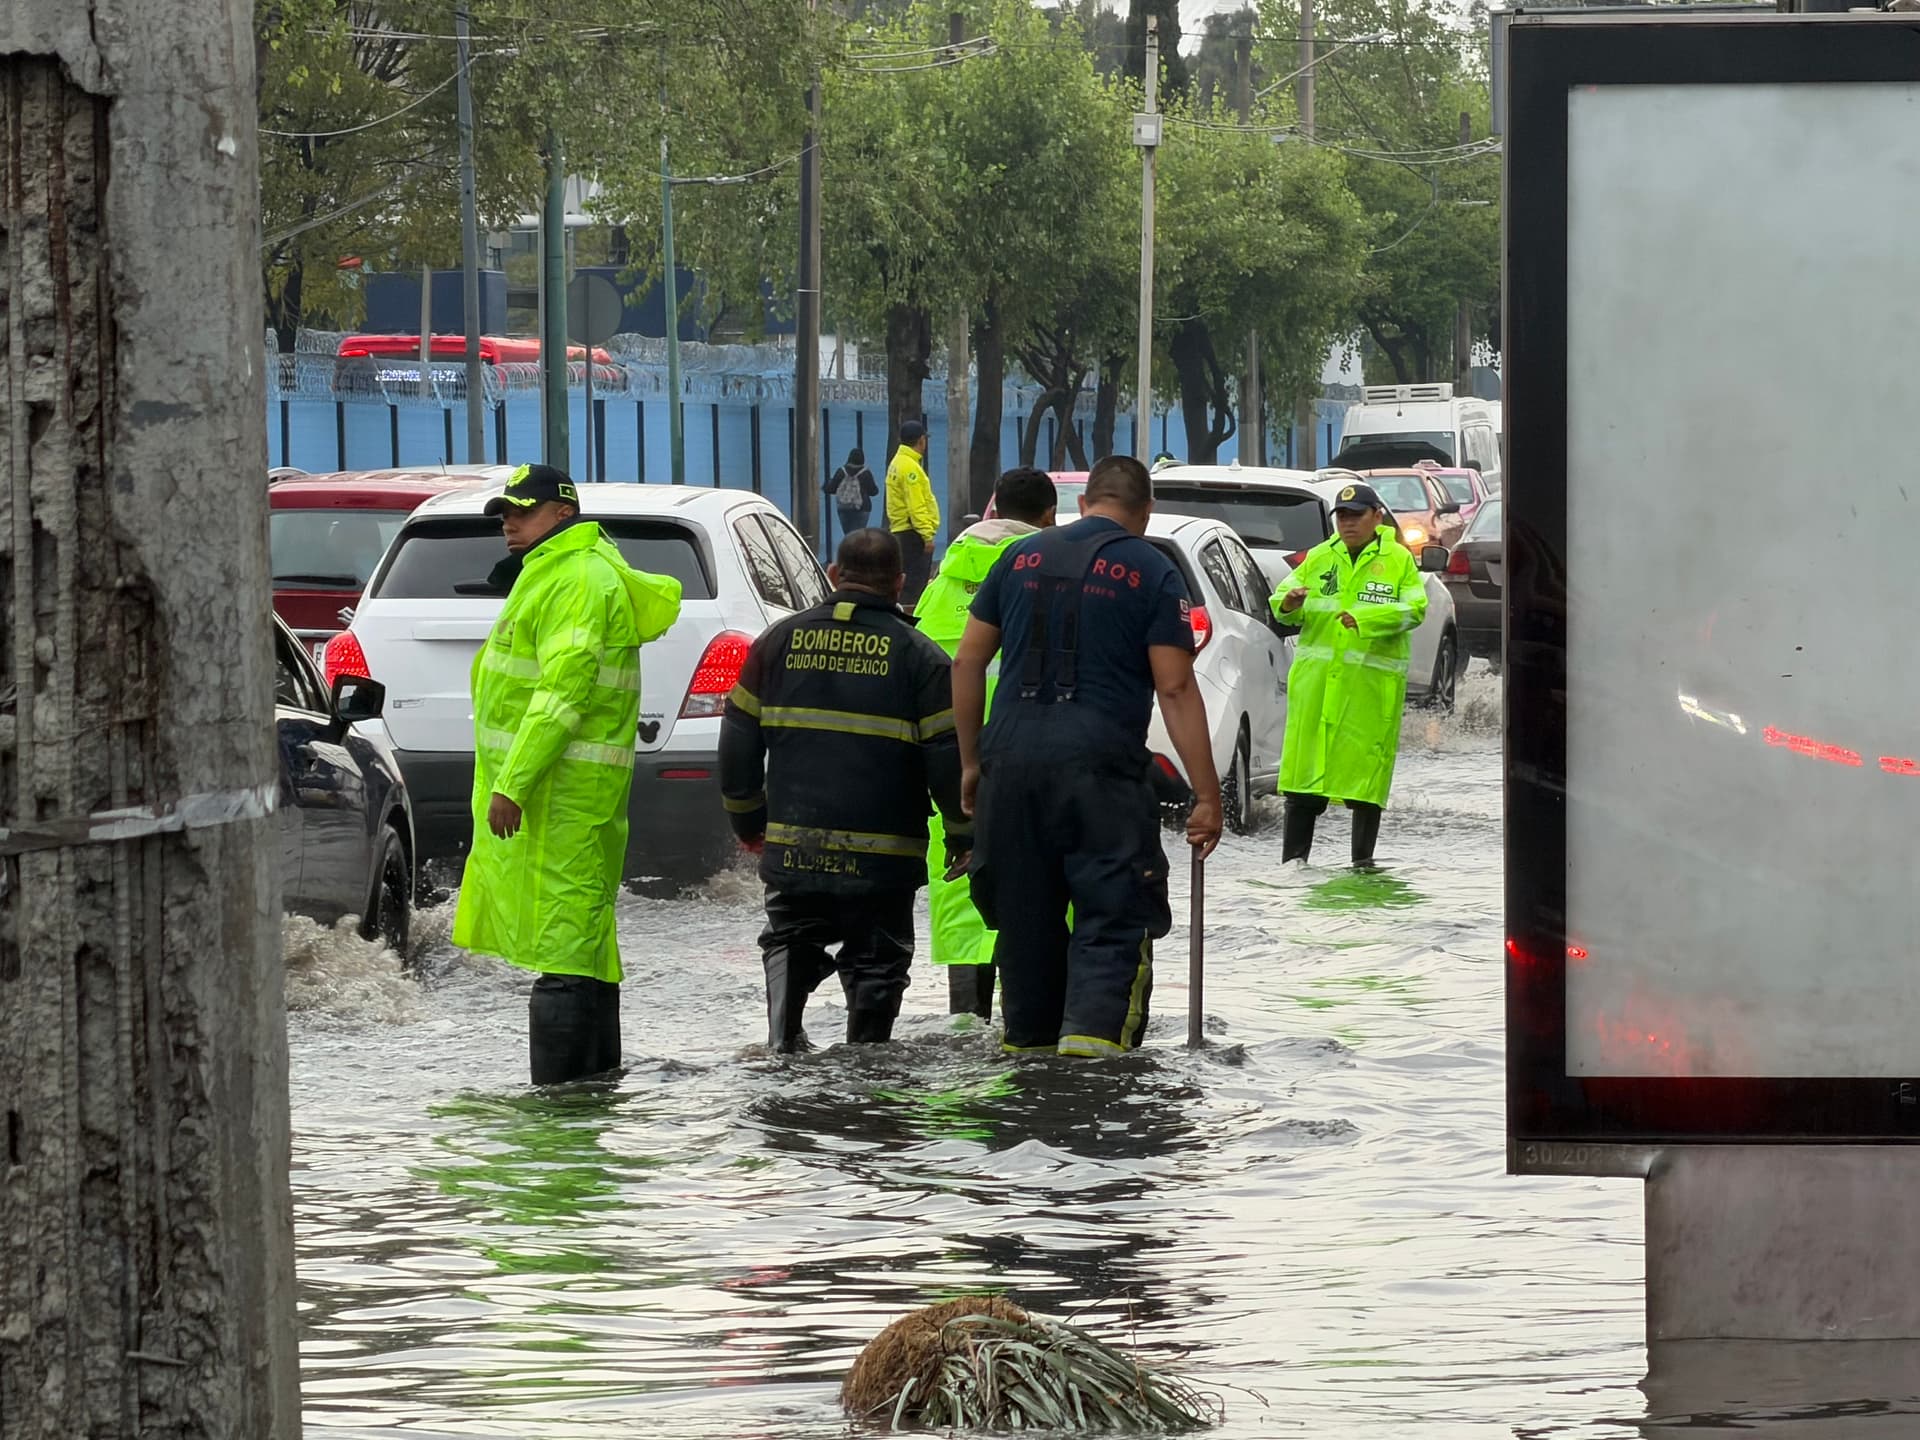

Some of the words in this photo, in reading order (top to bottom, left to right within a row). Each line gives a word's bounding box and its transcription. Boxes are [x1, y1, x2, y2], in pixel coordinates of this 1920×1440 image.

[1013, 552, 1141, 588] BOROS
[1366, 581, 1393, 594] SSC
[791, 628, 891, 656] BOMBEROS
[785, 653, 827, 670] CIUDAD
[828, 656, 844, 672] DE
[846, 656, 889, 676] MÉXICO
